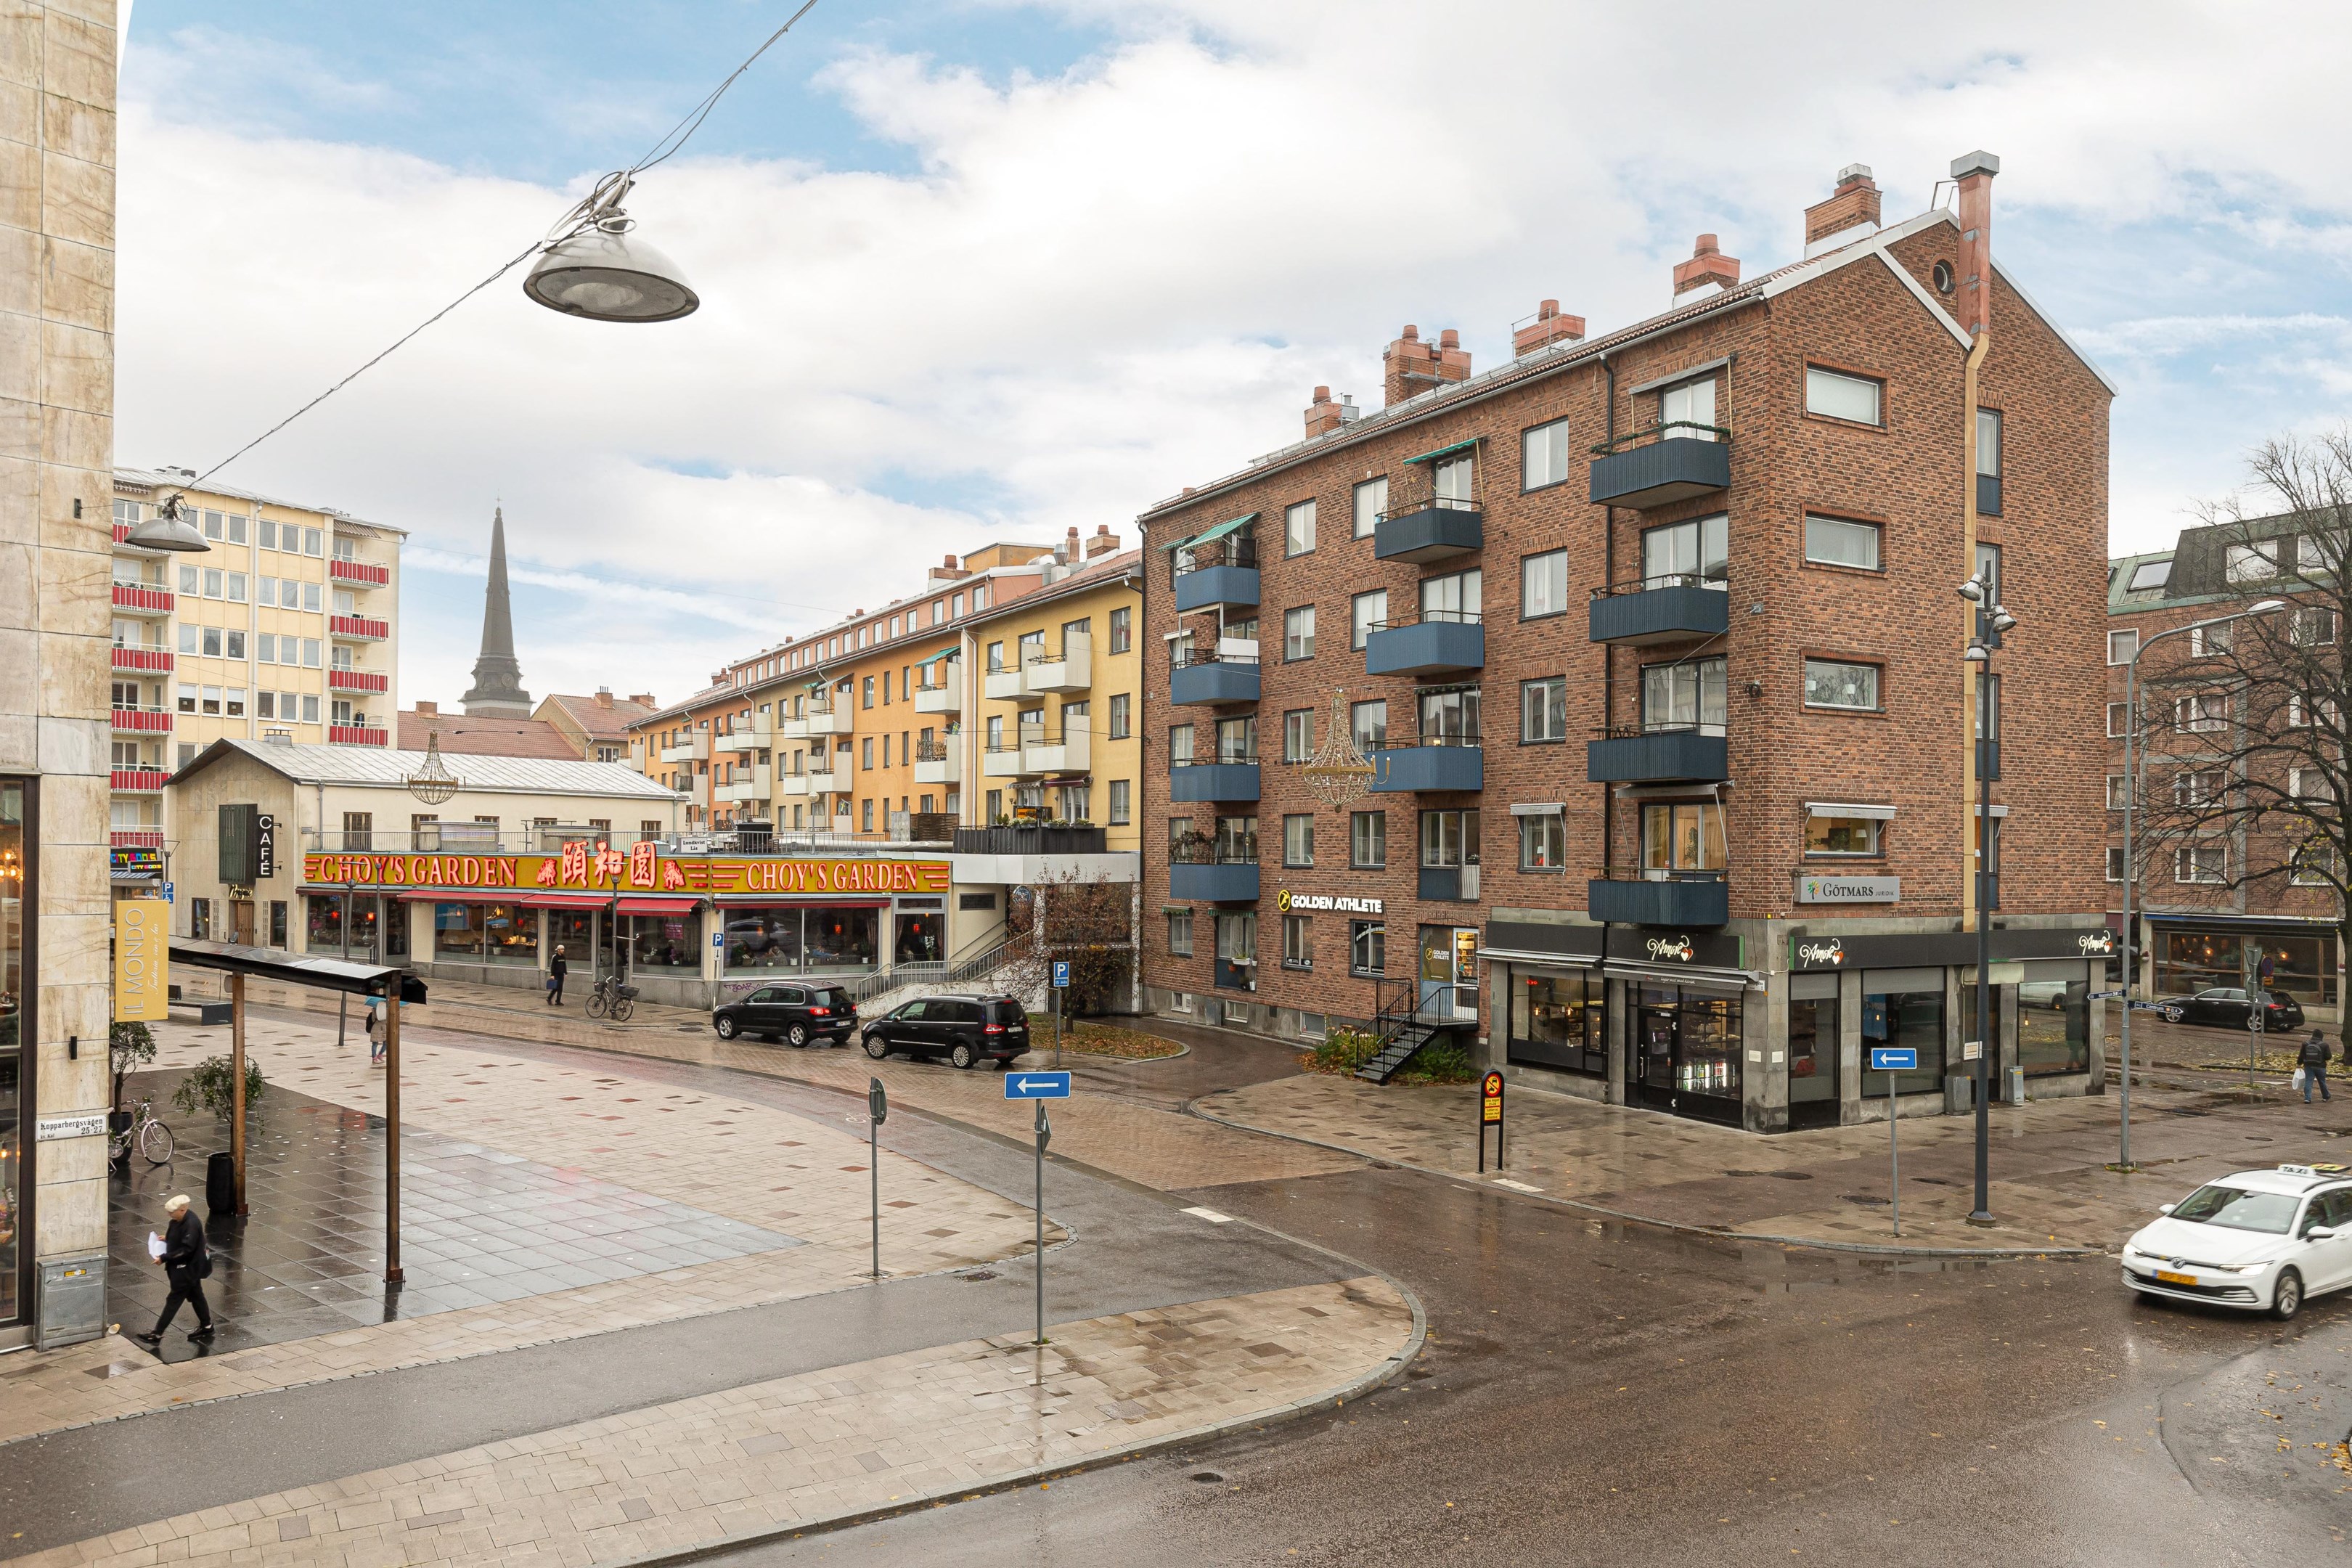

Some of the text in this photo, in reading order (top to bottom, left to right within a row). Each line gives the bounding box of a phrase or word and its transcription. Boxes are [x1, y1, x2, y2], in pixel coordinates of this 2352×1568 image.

[259, 817, 272, 875] CAFÉ
[110, 853, 128, 863] CITY
[320, 856, 518, 886] CHOY'S GARDEN
[747, 862, 918, 890] CHOY'S GARDEN
[164, 883, 171, 892] P
[1291, 895, 1382, 913] GOLDEN ATHLETE
[714, 934, 722, 945] P
[1647, 935, 1690, 960] Amore
[124, 908, 144, 1014] IL MONDO
[1800, 938, 1840, 968] Amore
[1057, 964, 1066, 976] P
[40, 1119, 103, 1131] Kopparbergsvägen
[2282, 1166, 2308, 1175] TAXI
